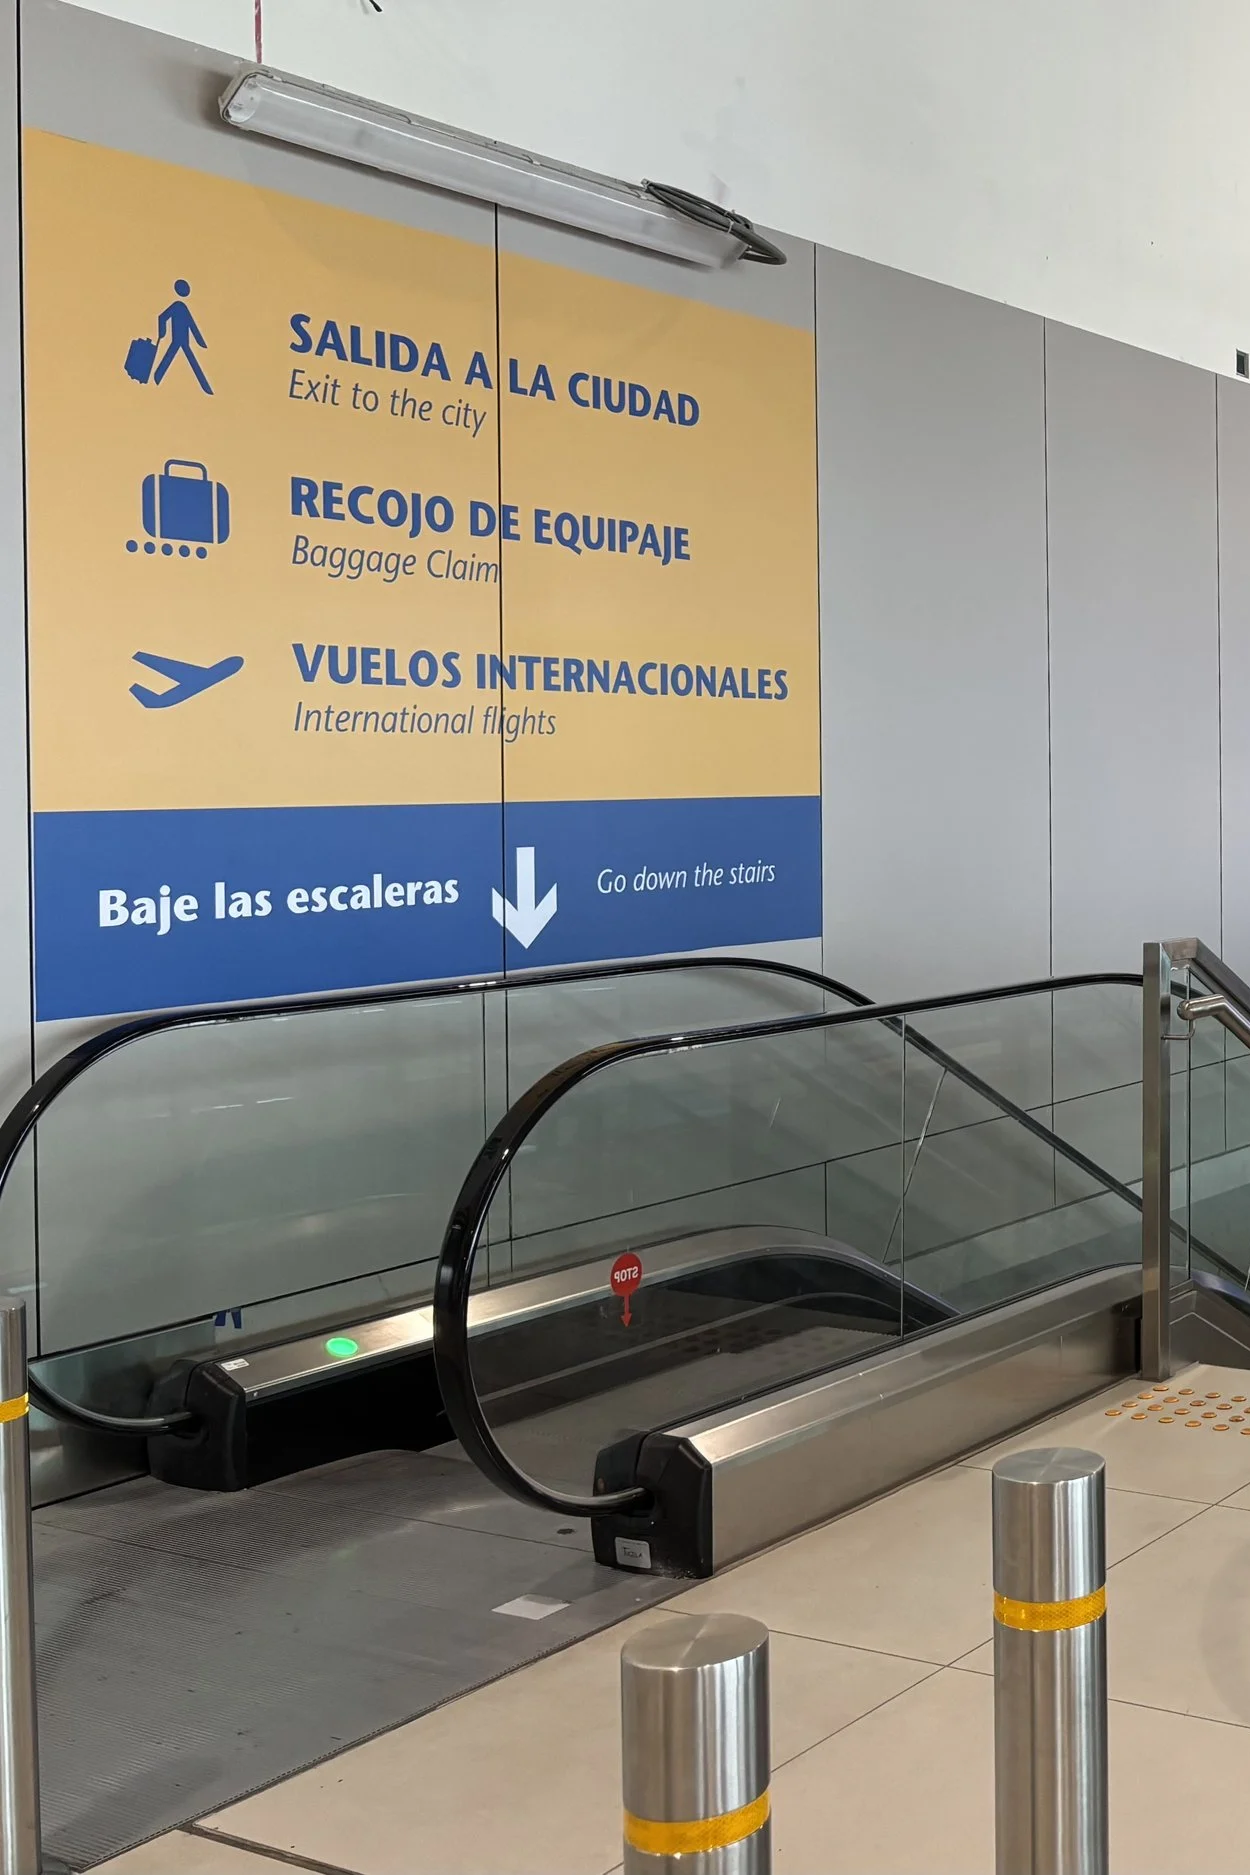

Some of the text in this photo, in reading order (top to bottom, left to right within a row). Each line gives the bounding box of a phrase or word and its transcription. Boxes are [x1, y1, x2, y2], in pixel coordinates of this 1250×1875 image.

[289, 313, 700, 427] SALIDA A LA CIUDAD
[288, 368, 487, 438] Exit to the city
[290, 476, 691, 566] RECOJO DE EQUIPAJE
[291, 535, 499, 583] Baggage Claim
[292, 643, 789, 700] VUELOS INTERNACIONALES
[294, 701, 556, 743] International flights
[99, 873, 459, 935] Baje las escaleras
[597, 859, 776, 894] Go down the stairs
